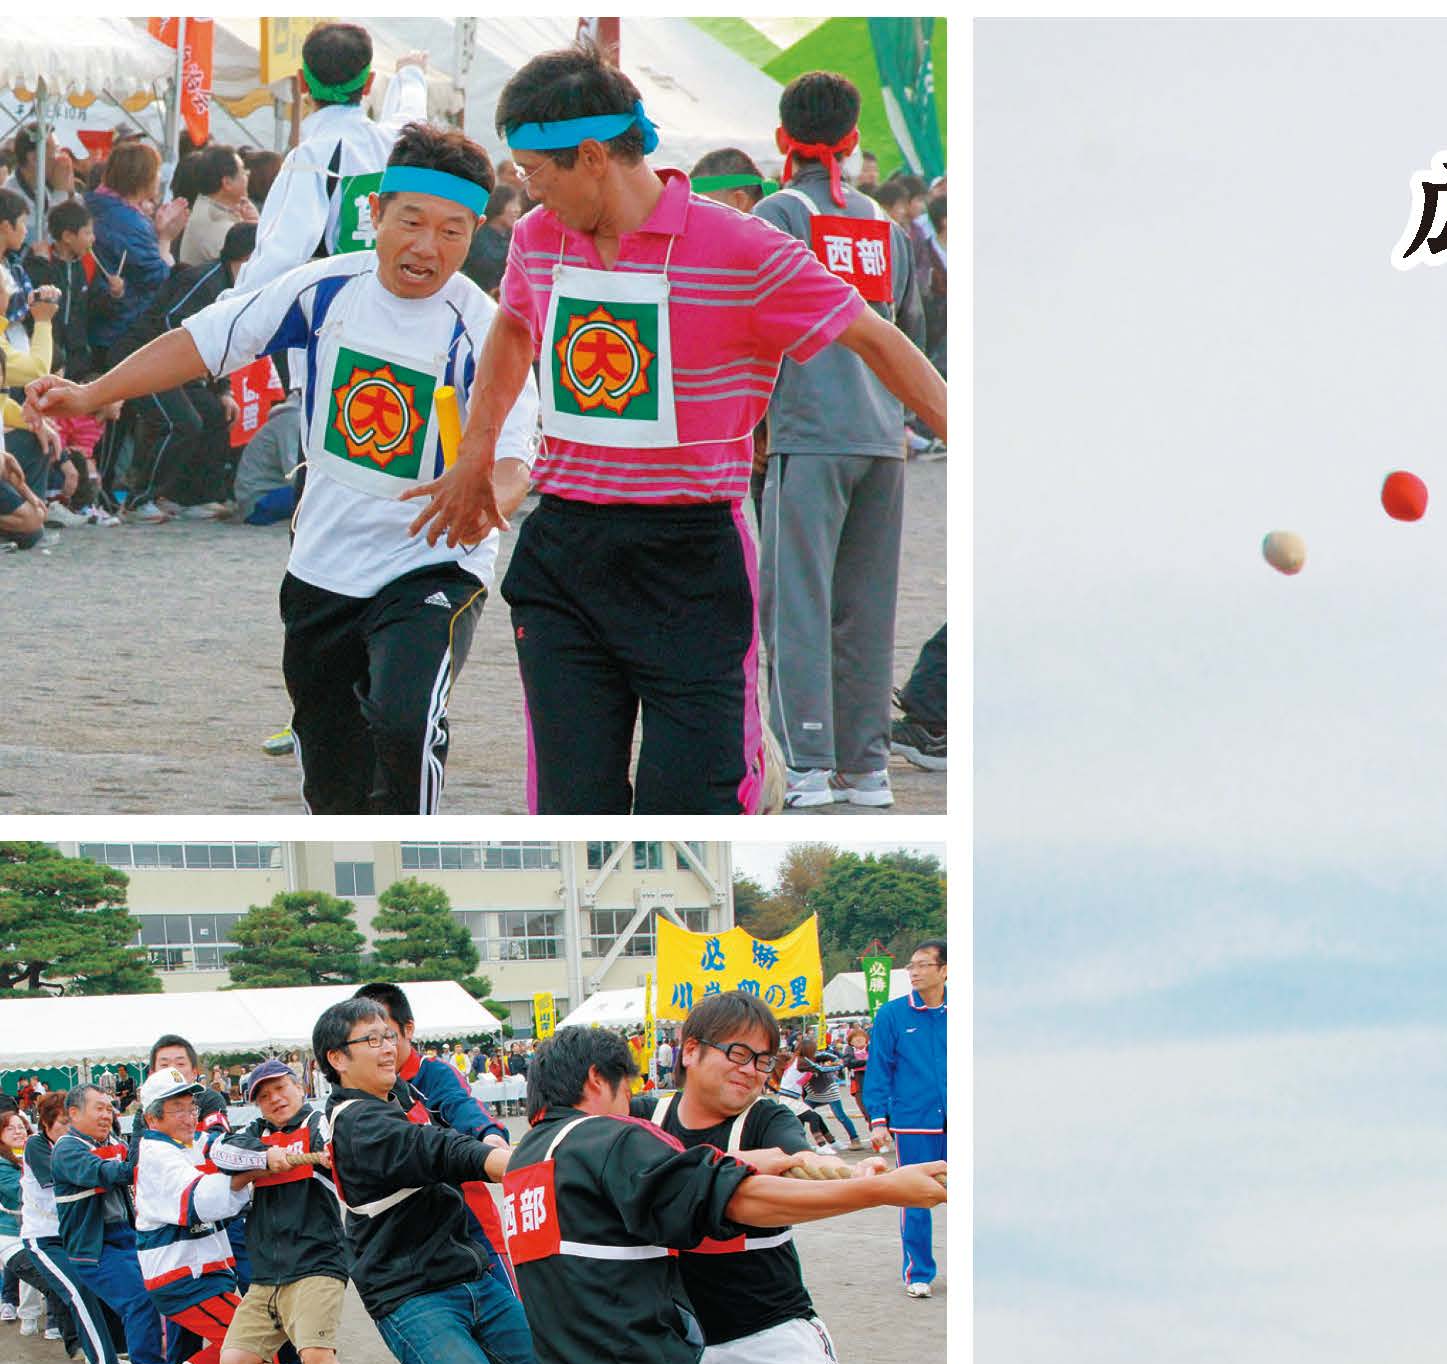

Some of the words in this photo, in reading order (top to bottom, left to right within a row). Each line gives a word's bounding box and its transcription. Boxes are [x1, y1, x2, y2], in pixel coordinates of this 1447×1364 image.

[823, 235, 886, 276] 西部
[701, 937, 780, 971] 必勝
[500, 1186, 547, 1239] 西部
